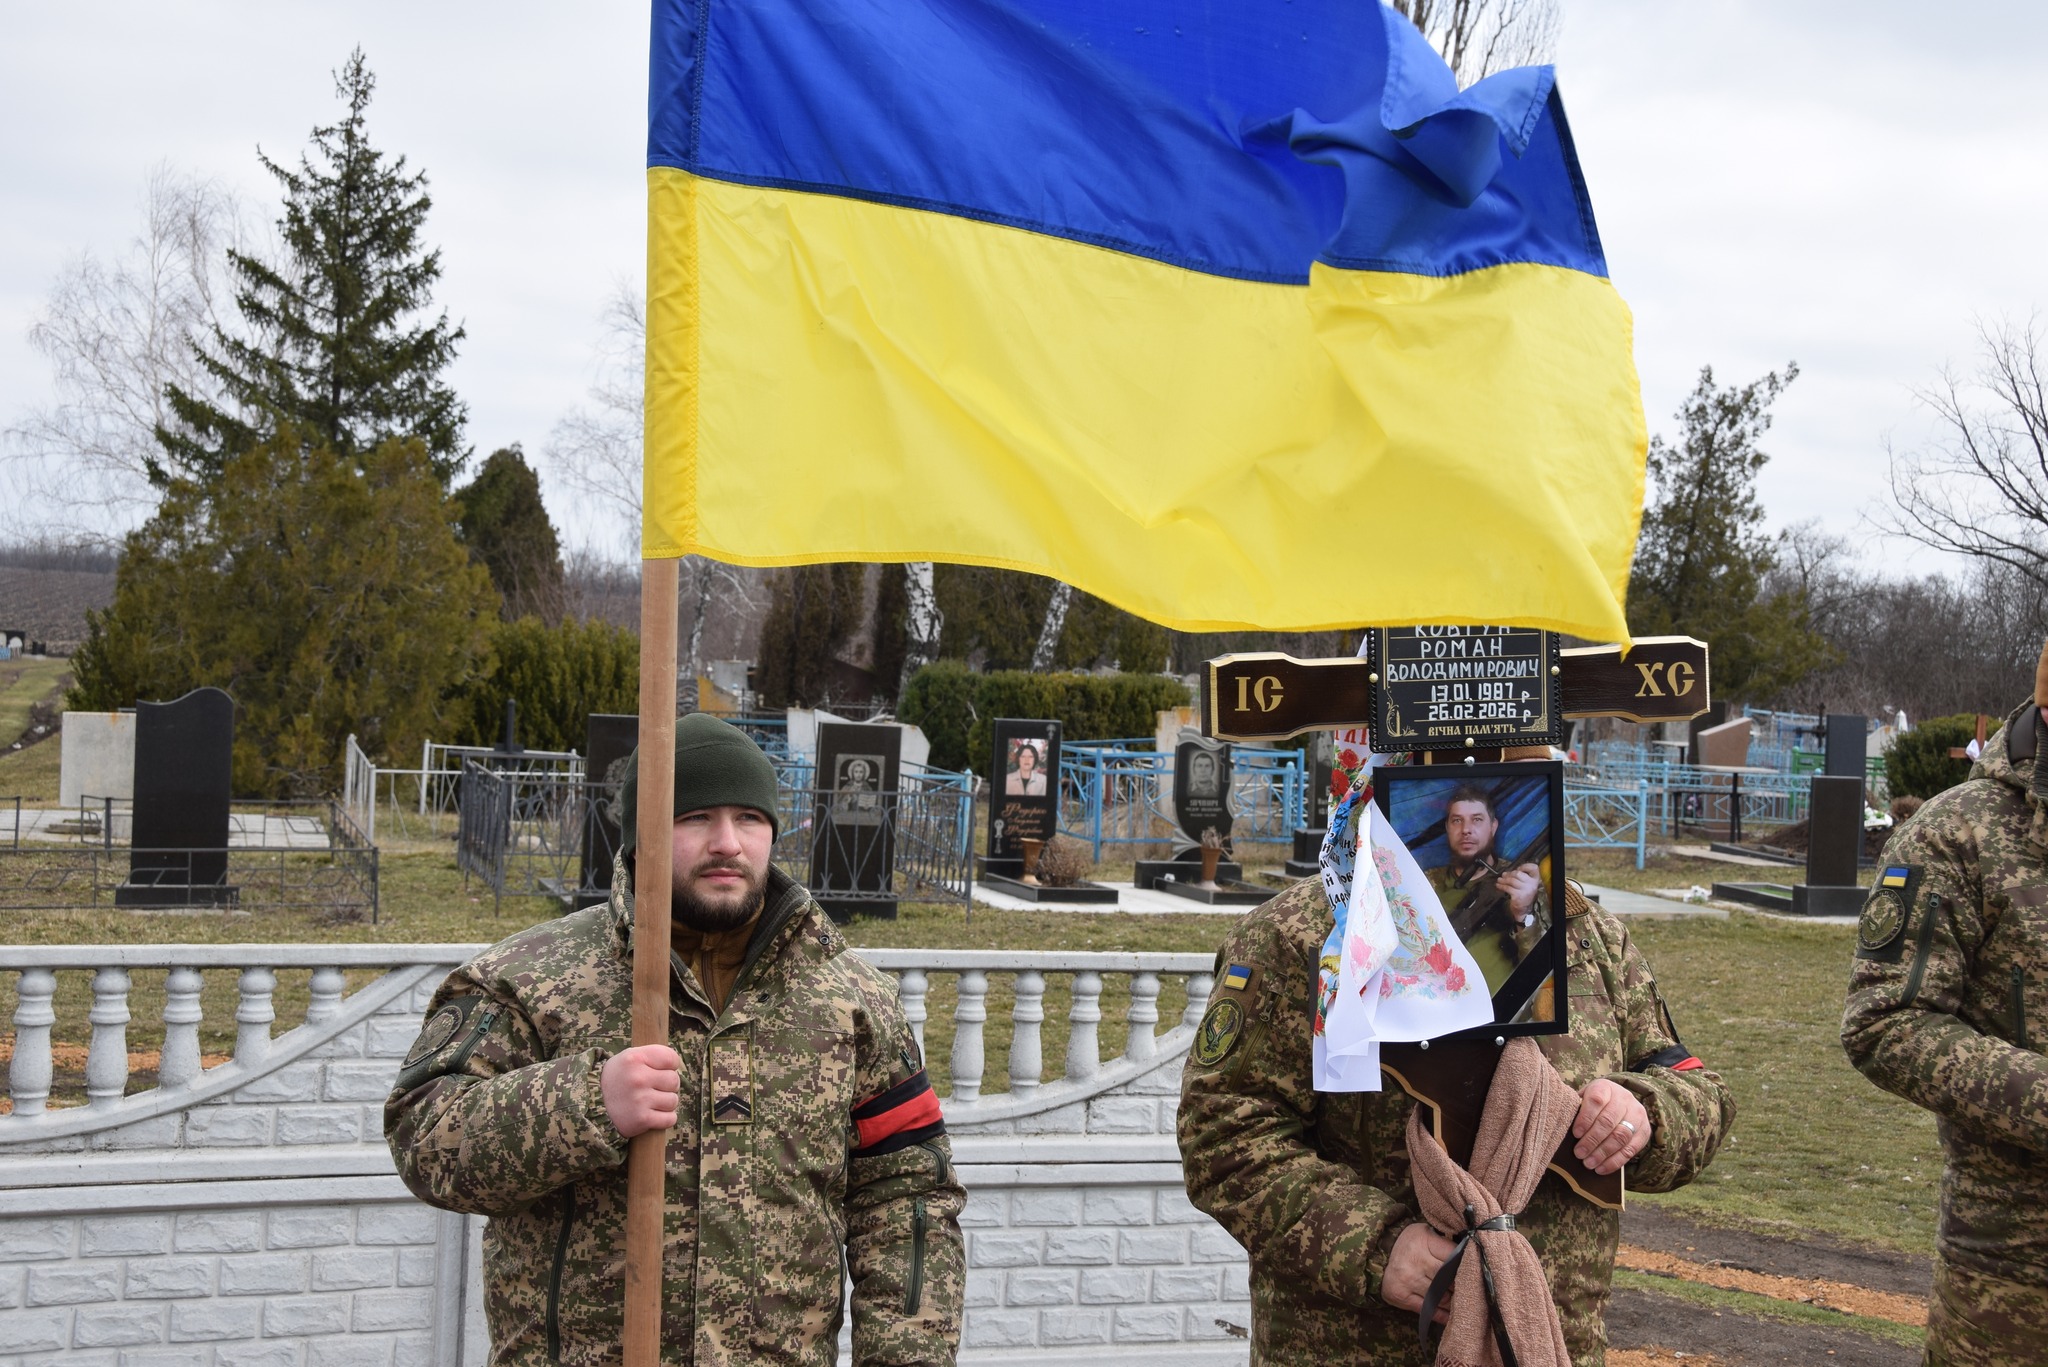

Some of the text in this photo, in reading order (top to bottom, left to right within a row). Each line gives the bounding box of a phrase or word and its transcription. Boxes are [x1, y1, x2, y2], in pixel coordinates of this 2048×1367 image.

[1421, 637, 1503, 658] РОМАН
[1387, 659, 1539, 681] ВОЛОДИМИРОВИЧ
[1431, 683, 1513, 702] 13.01.1987
[1429, 703, 1517, 720] 26.02.2026
[1427, 723, 1517, 737] ВІЧНА ПАМ'ЯТЬ
